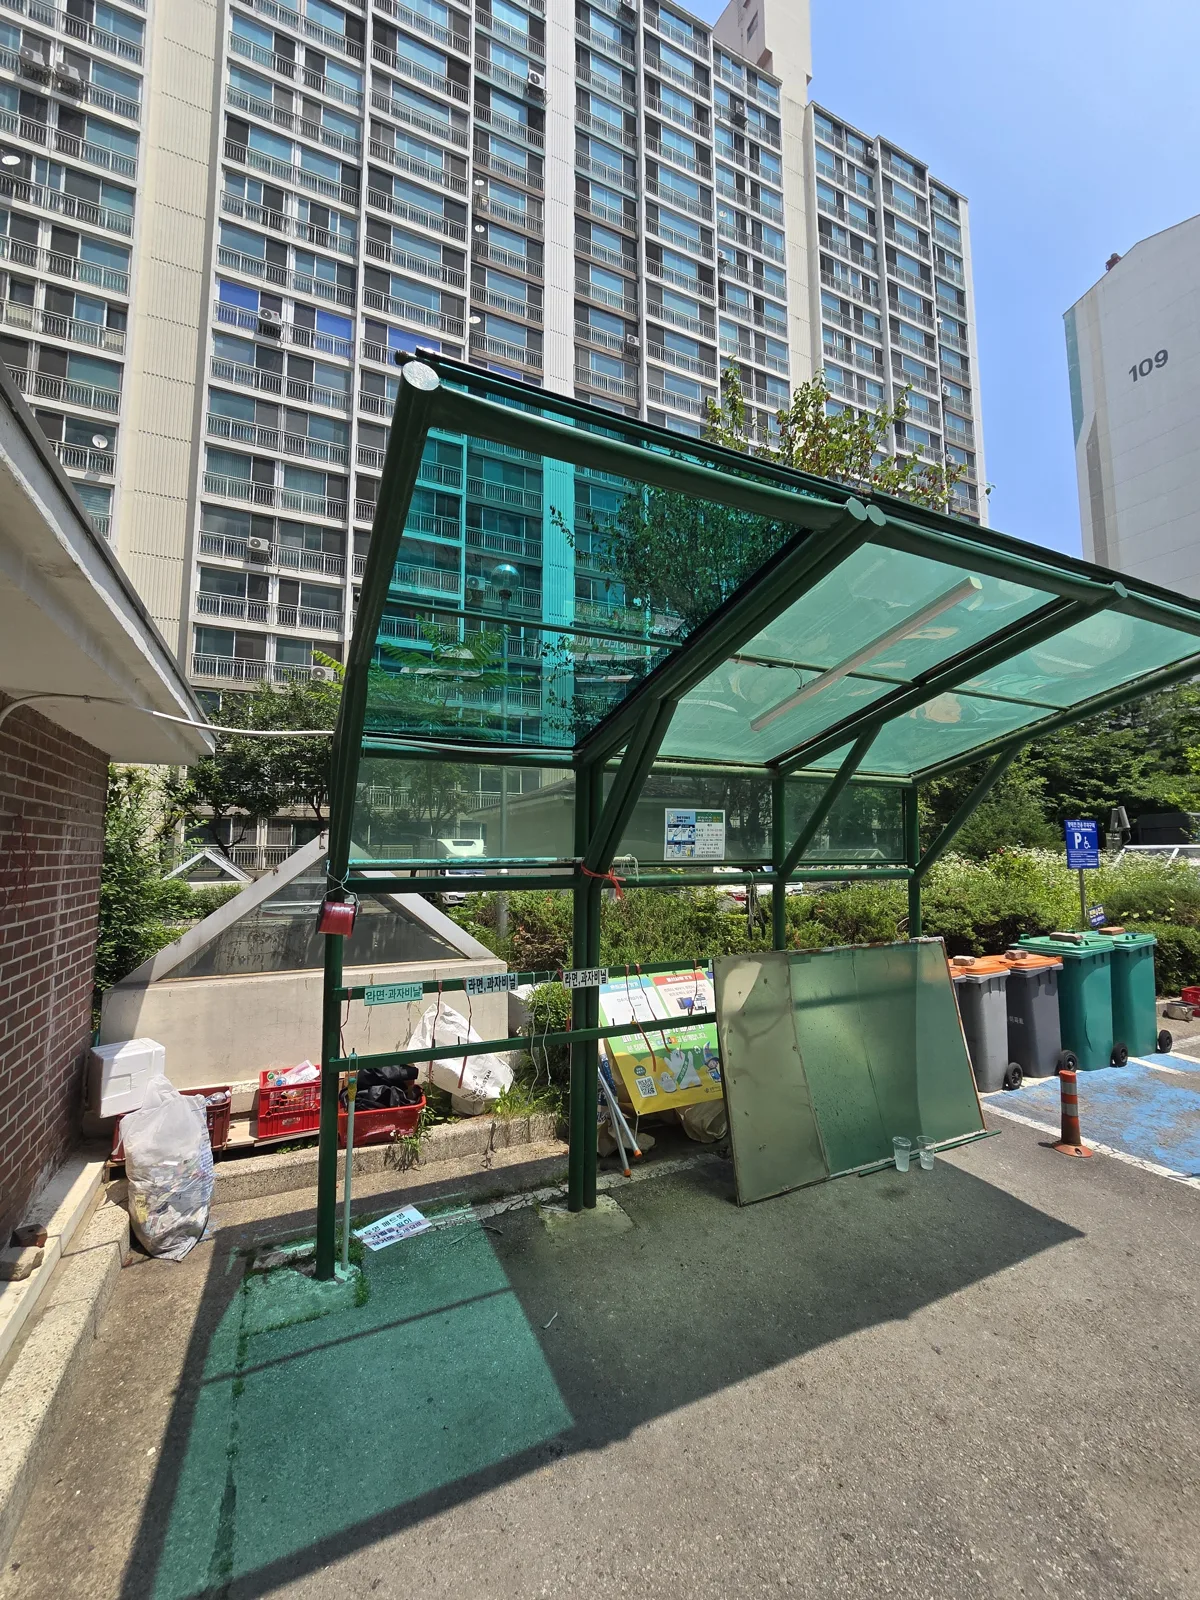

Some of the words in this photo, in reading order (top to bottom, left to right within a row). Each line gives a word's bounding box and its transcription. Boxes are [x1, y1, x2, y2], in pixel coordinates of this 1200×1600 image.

[1128, 349, 1168, 382] 109
[1074, 832, 1082, 849] P
[468, 973, 516, 993] 라면,과자비닐
[564, 969, 607, 987] 라면,과자비닐
[382, 1212, 405, 1227] 페트병
